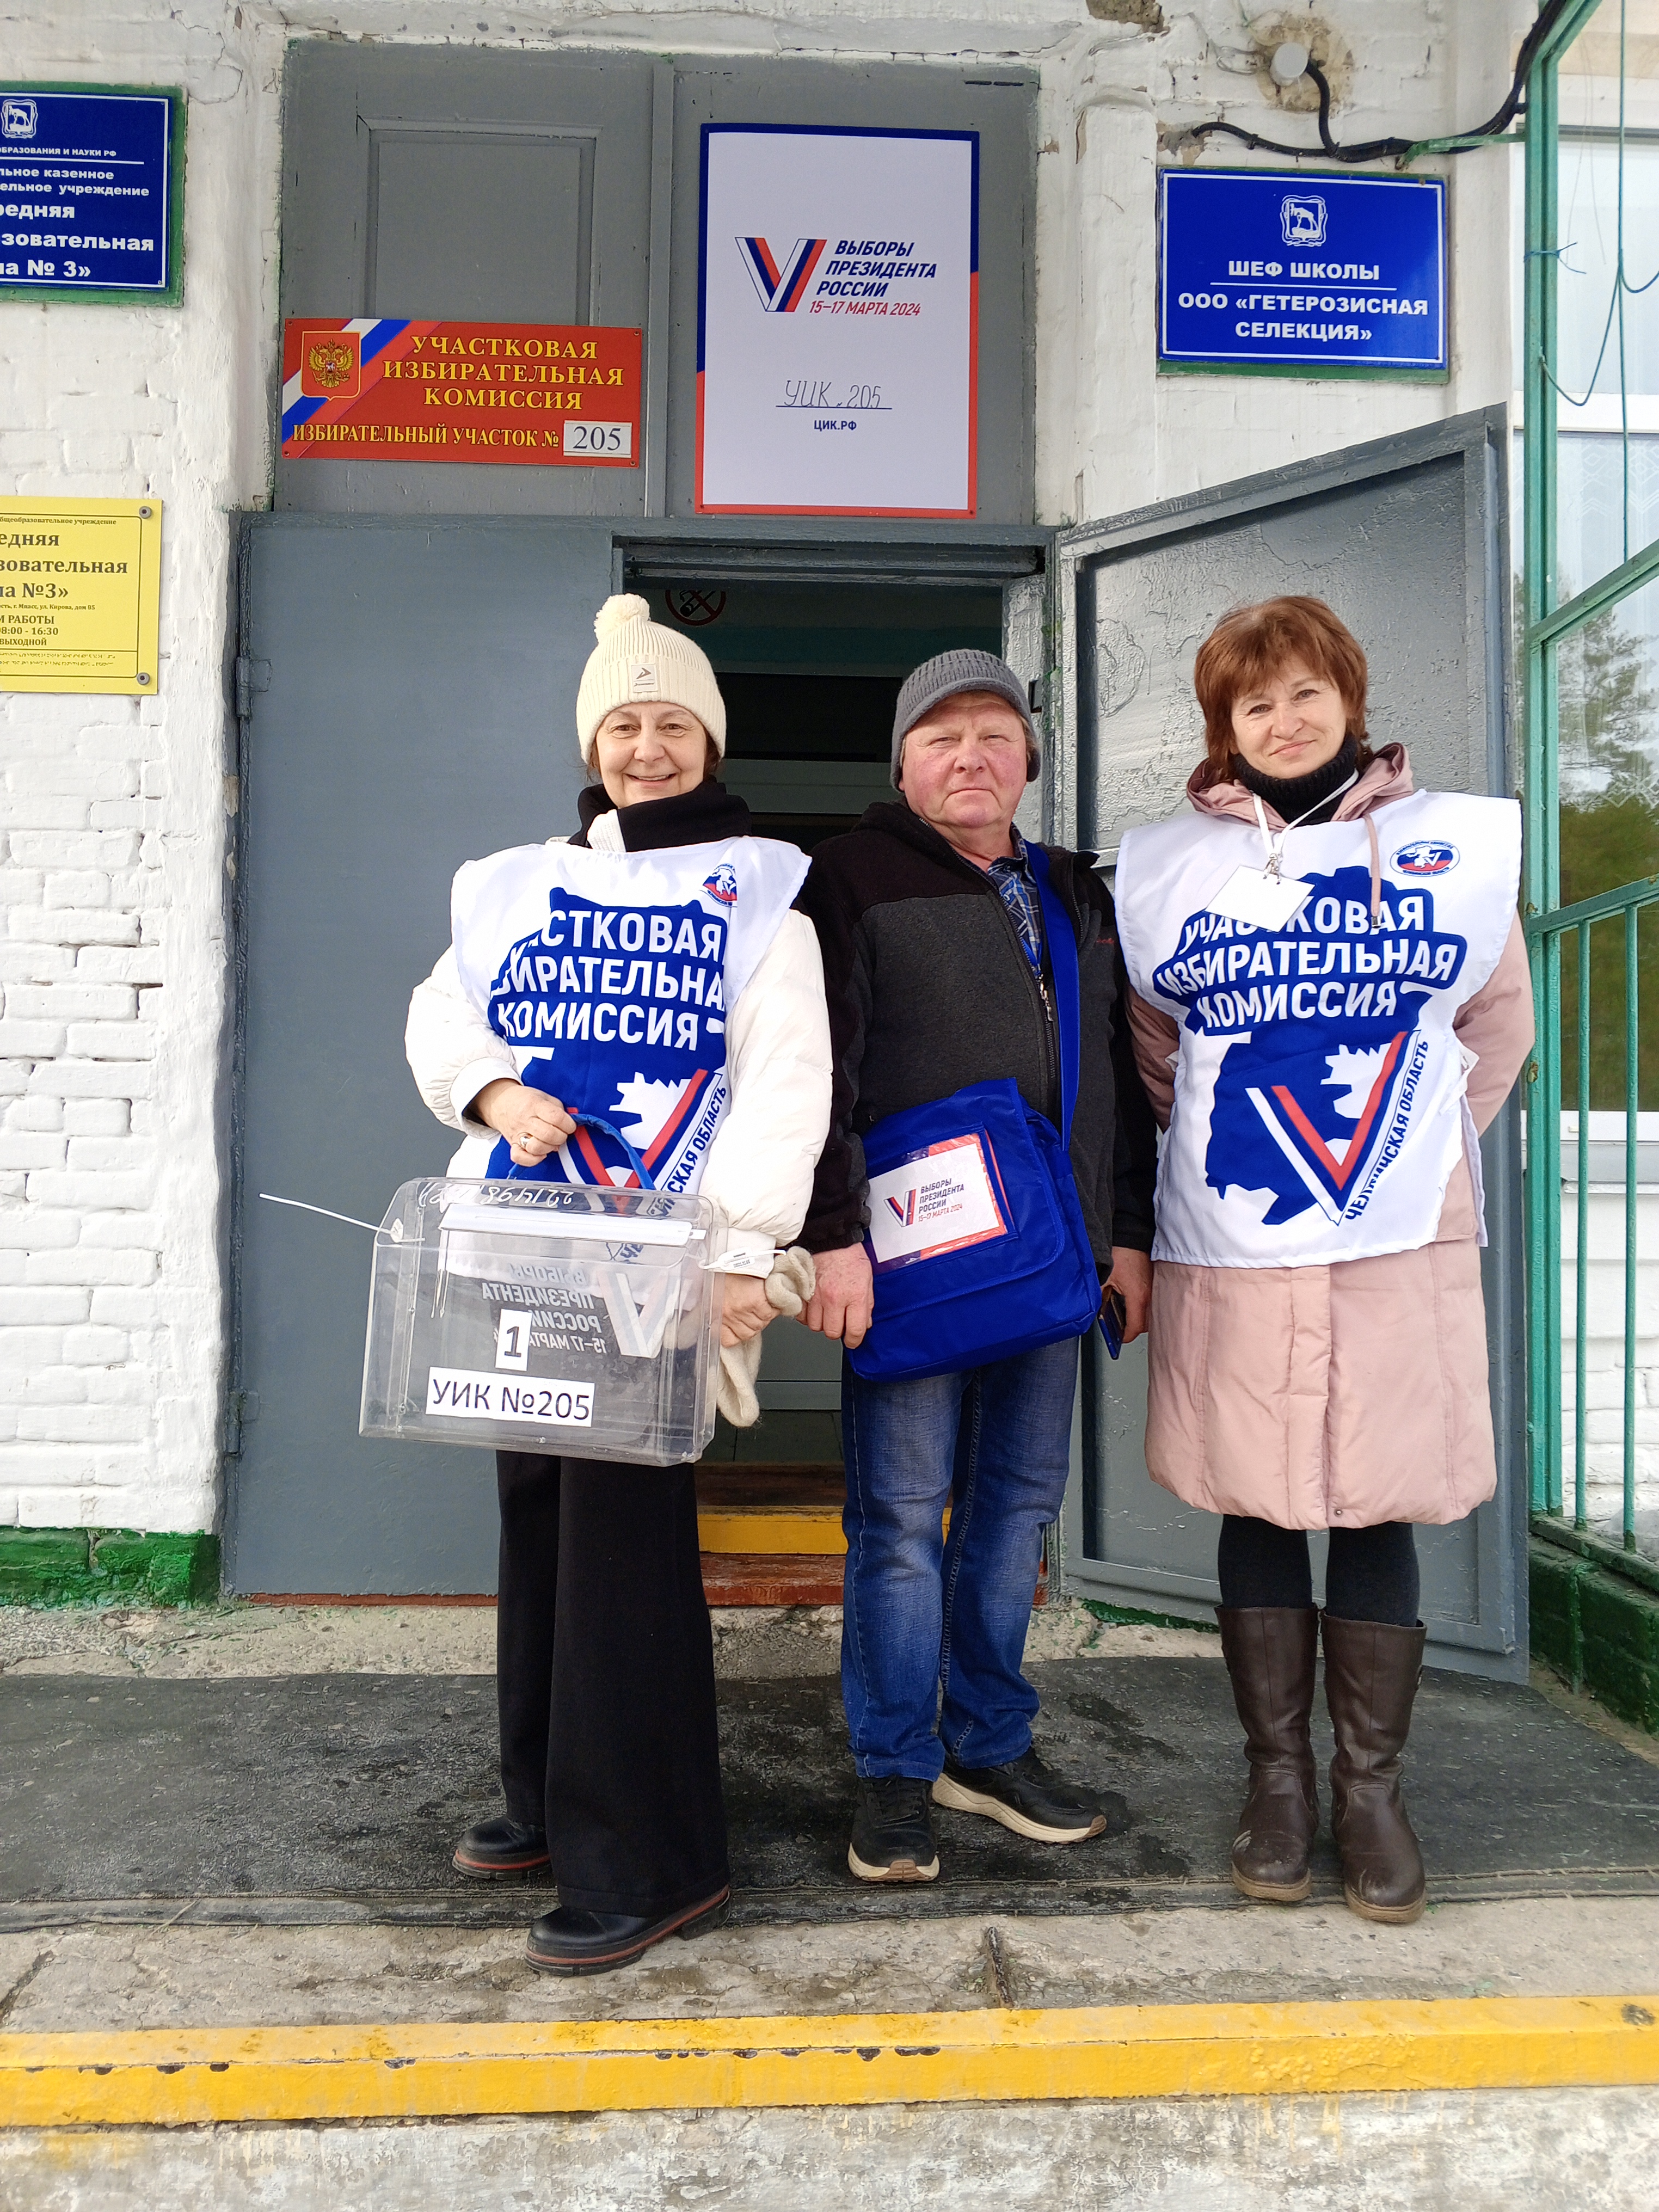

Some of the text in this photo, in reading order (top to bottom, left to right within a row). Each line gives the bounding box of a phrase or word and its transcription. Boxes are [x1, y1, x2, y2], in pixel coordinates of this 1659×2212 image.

[0, 146, 61, 155] БРАЗОВАНИЯ
[44, 169, 114, 180] казенное
[59, 185, 150, 196] учреждение
[1, 233, 154, 251] зовательная
[834, 240, 915, 257] ВЫБОРЫ
[825, 260, 937, 279] ПРЕЗИДЕНТА
[1228, 260, 1380, 280] ШЕФ ШКОЛЫ
[816, 281, 889, 297] РОССИИ
[845, 301, 889, 315] МАРТА
[889, 303, 921, 316] 2024
[1178, 292, 1428, 316] ООО «ГЕТЕРОЗИСНАЯ
[1235, 321, 1372, 342] СЕЛЕКЦИЯ»
[411, 335, 598, 359] УЧАСТКОВАЯ
[382, 360, 624, 386] ИЗБИРАТЕЛЬНАЯ
[423, 388, 583, 409] КОМИССИЯ
[846, 385, 881, 408] 205
[292, 422, 447, 444] ИЗБИРАТЕЛЬНЫЙ
[453, 427, 538, 447] УЧАСТОК
[572, 425, 622, 451] 205
[814, 420, 857, 432] ЦИК.РФ
[8, 615, 55, 624] РАБОТЫ
[0, 626, 23, 635] 8:00
[32, 627, 59, 636] 16:30
[1178, 896, 1424, 955] УЧАКОВАЯ
[527, 910, 722, 963] СТКОВАЯ
[1156, 939, 1458, 997] ИЗБИРАТЕЛЬНАЯ
[491, 956, 725, 1012] ИРАТЕЛЬНА
[1196, 980, 1397, 1028] КОМИССИЯ
[497, 1000, 699, 1051] КОМИССИЯ
[1399, 1041, 1429, 1112] ОБЛАСТЬ
[692, 1087, 727, 1151] ОБЛАСТЬ
[919, 1183, 964, 1204] ПРЕЗИДЕНТА
[920, 1178, 952, 1194] ВЫБОРЫ
[918, 1199, 947, 1214] РОССИИ
[503, 1325, 522, 1358] 1
[433, 1379, 491, 1410] УИК
